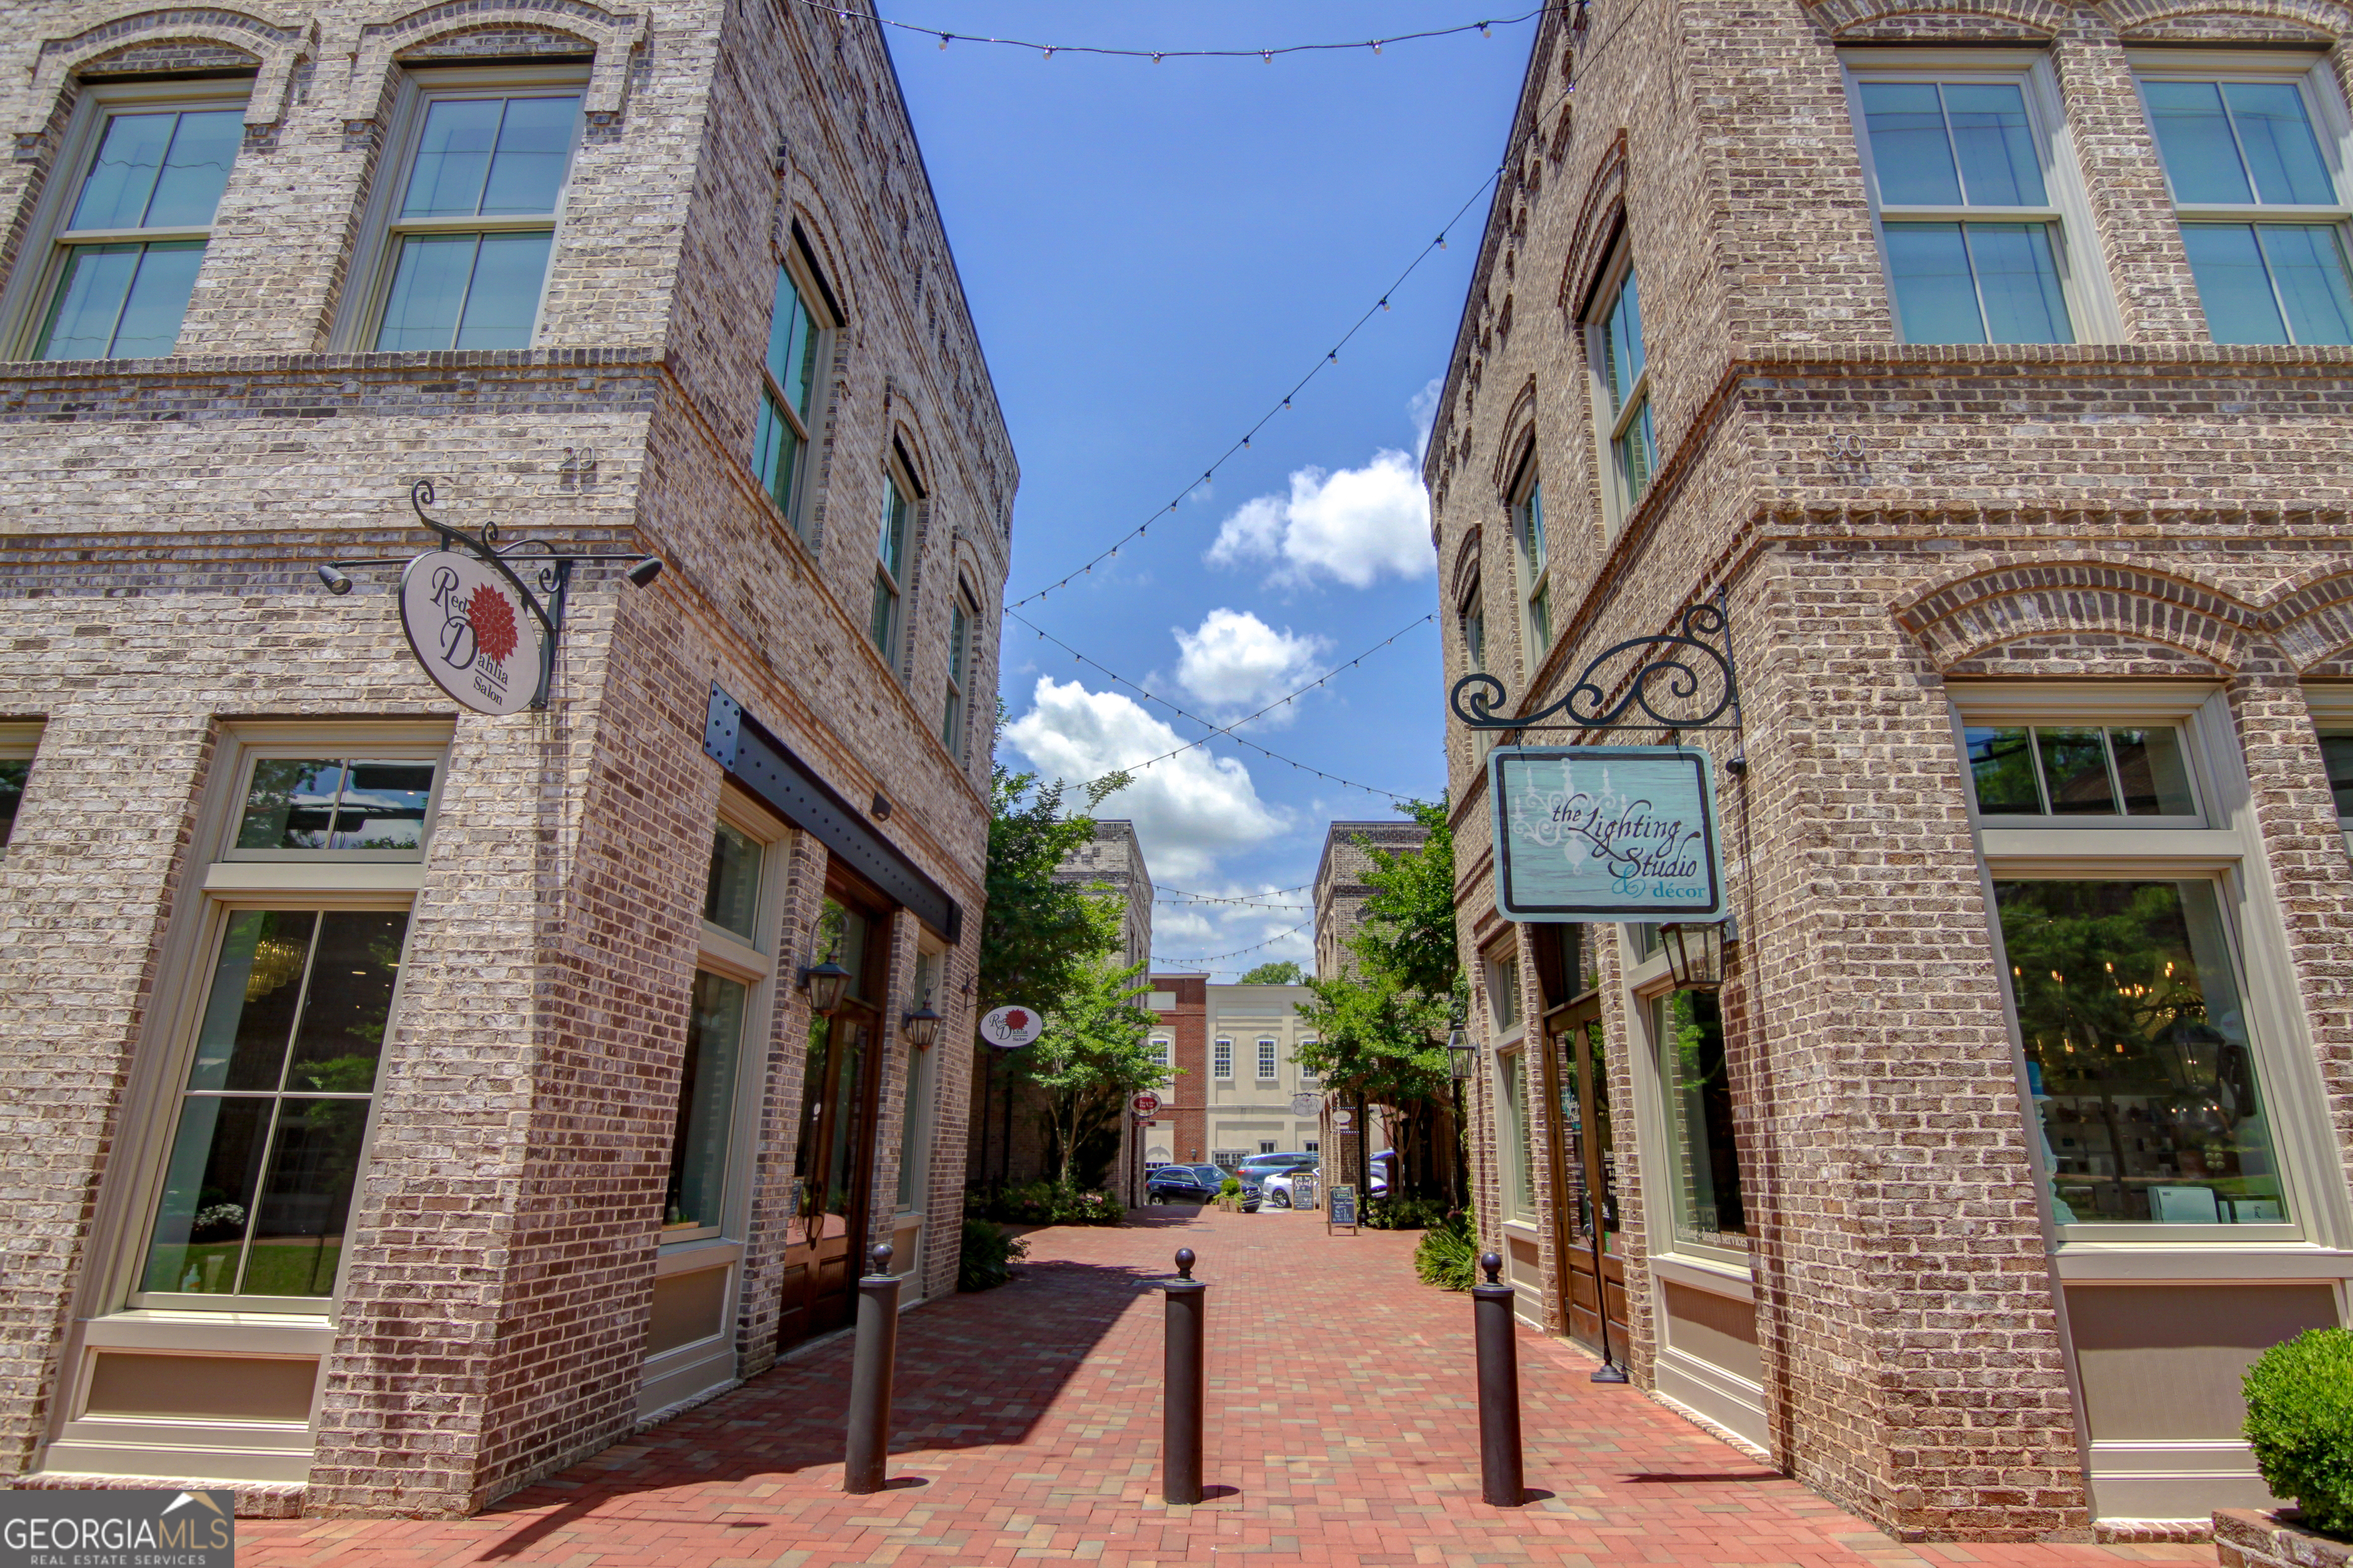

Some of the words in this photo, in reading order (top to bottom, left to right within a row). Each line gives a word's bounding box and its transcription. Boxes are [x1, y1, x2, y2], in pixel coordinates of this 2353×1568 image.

[430, 566, 468, 627] Red
[440, 615, 509, 686] Dahlia
[473, 676, 503, 706] Salon
[1552, 793, 1588, 823] the
[1568, 799, 1682, 860] Lighting
[1608, 830, 1702, 879] Studio
[1612, 864, 1647, 899] &
[1653, 882, 1707, 899] décor
[989, 1013, 1006, 1029] Red
[996, 1023, 1028, 1040] Dahlia
[1676, 1223, 1698, 1242] lighting
[1701, 1226, 1721, 1246] design
[1721, 1231, 1748, 1248] services
